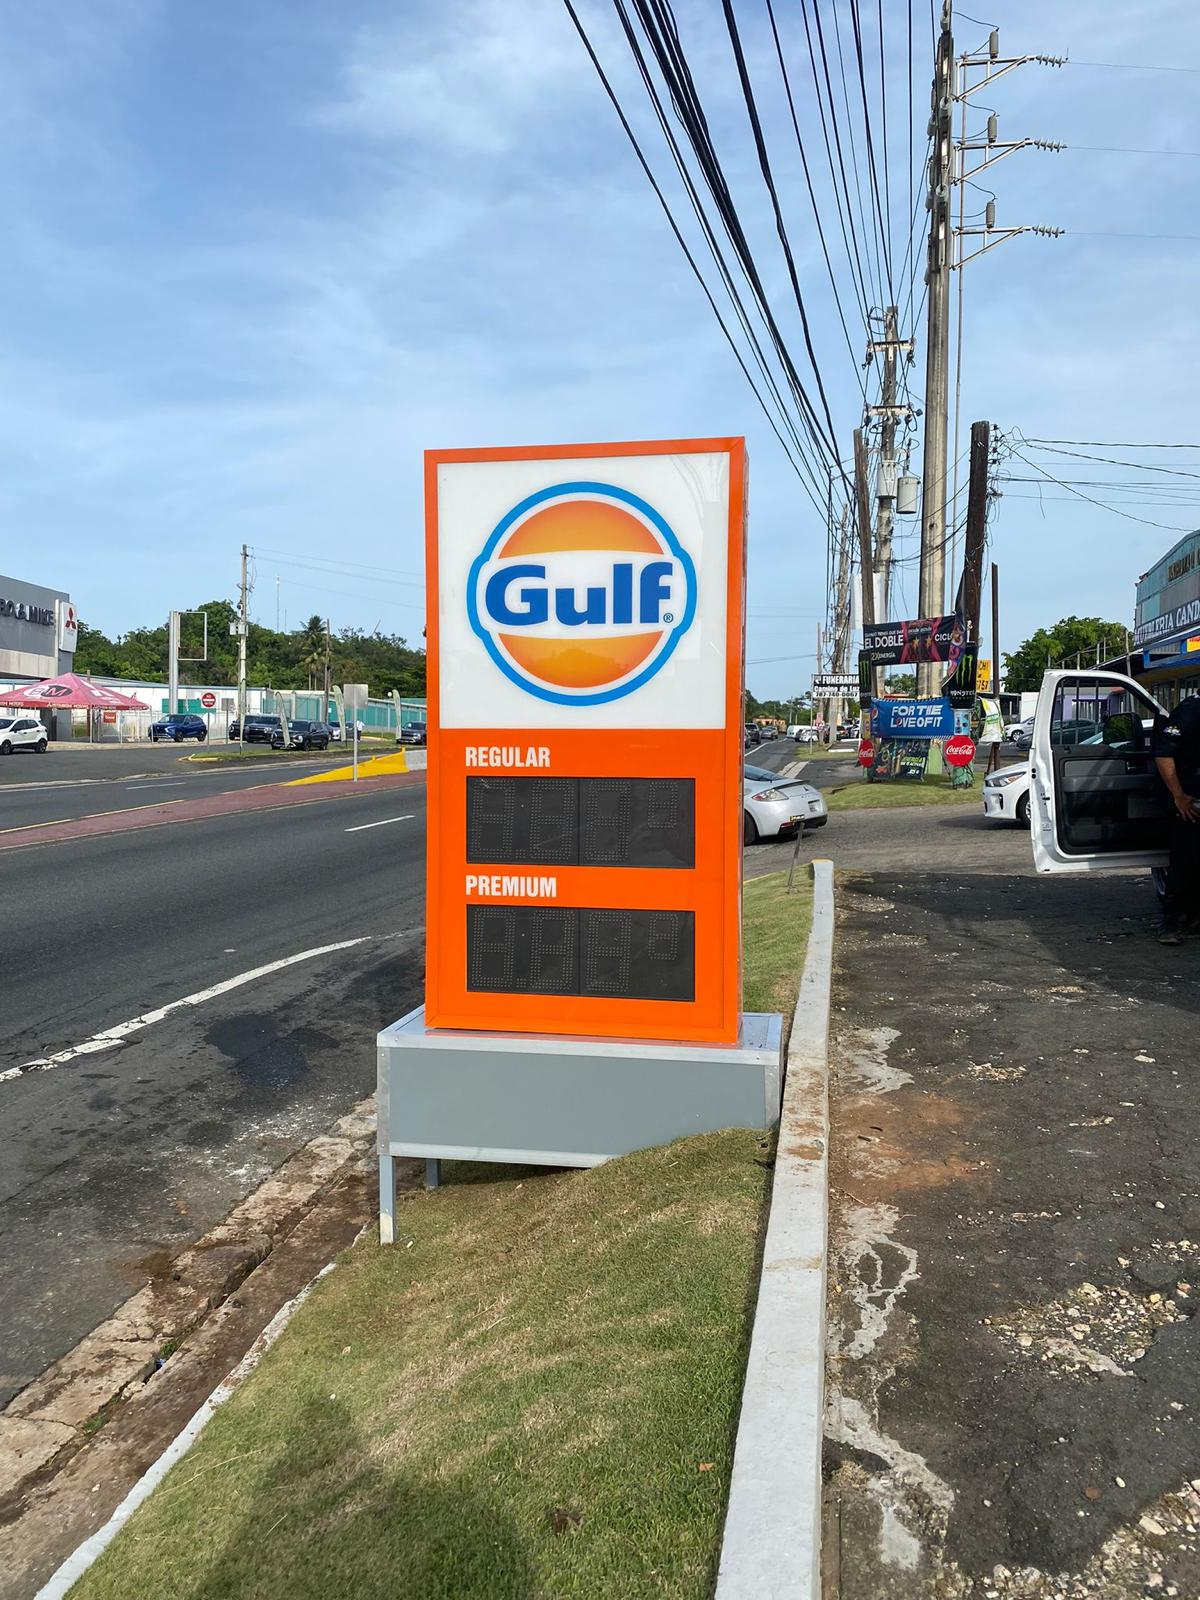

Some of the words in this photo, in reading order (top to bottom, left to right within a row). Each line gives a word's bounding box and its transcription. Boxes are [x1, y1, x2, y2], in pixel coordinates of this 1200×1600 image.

[485, 561, 674, 626] Gulf
[865, 638, 874, 649] EL
[875, 635, 904, 648] DOBLE
[822, 675, 860, 684] FUNERARIA
[891, 705, 915, 716] FOR
[916, 716, 931, 728] OF
[932, 716, 943, 727] IT
[465, 746, 551, 768] REGULAR
[465, 875, 557, 898] PREMIUM
